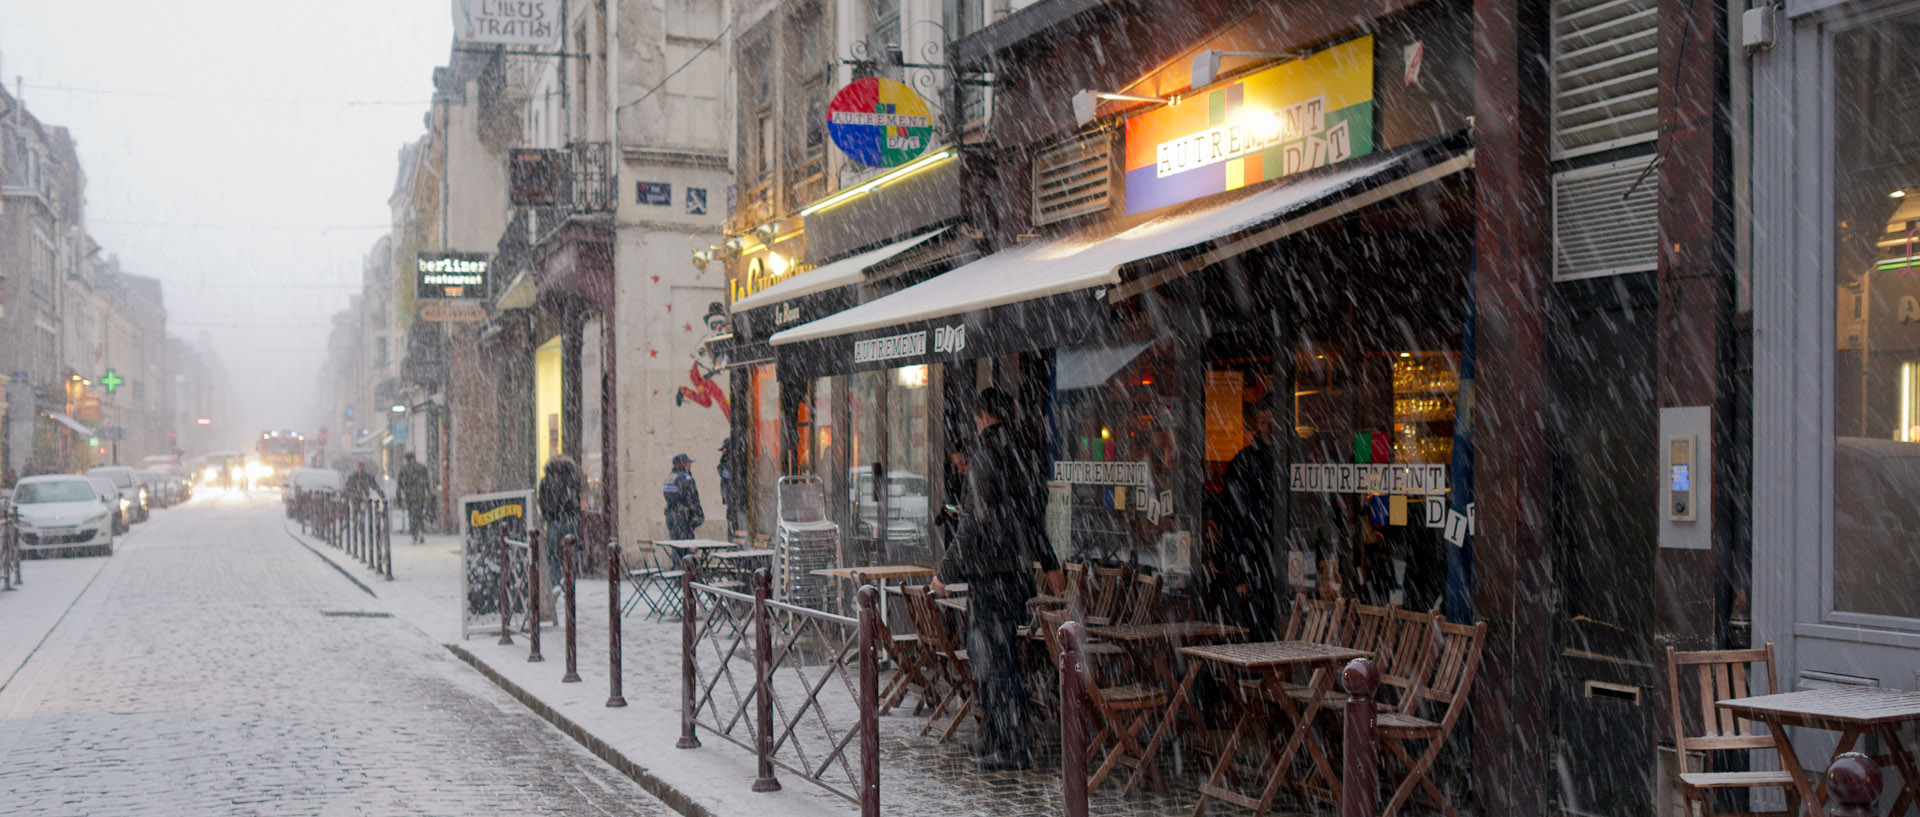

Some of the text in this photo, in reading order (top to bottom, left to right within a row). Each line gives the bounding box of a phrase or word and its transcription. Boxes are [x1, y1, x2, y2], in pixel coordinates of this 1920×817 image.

[834, 112, 927, 127] AUTREMENT
[888, 136, 918, 149] DIT
[1285, 126, 1345, 176] DIT
[418, 257, 487, 273] berliner
[855, 325, 965, 362] AUTREMENT DIT
[1055, 462, 1147, 484] AUTREMENT
[1291, 466, 1443, 493] AUTREMENT
[1137, 488, 1171, 521] DIT
